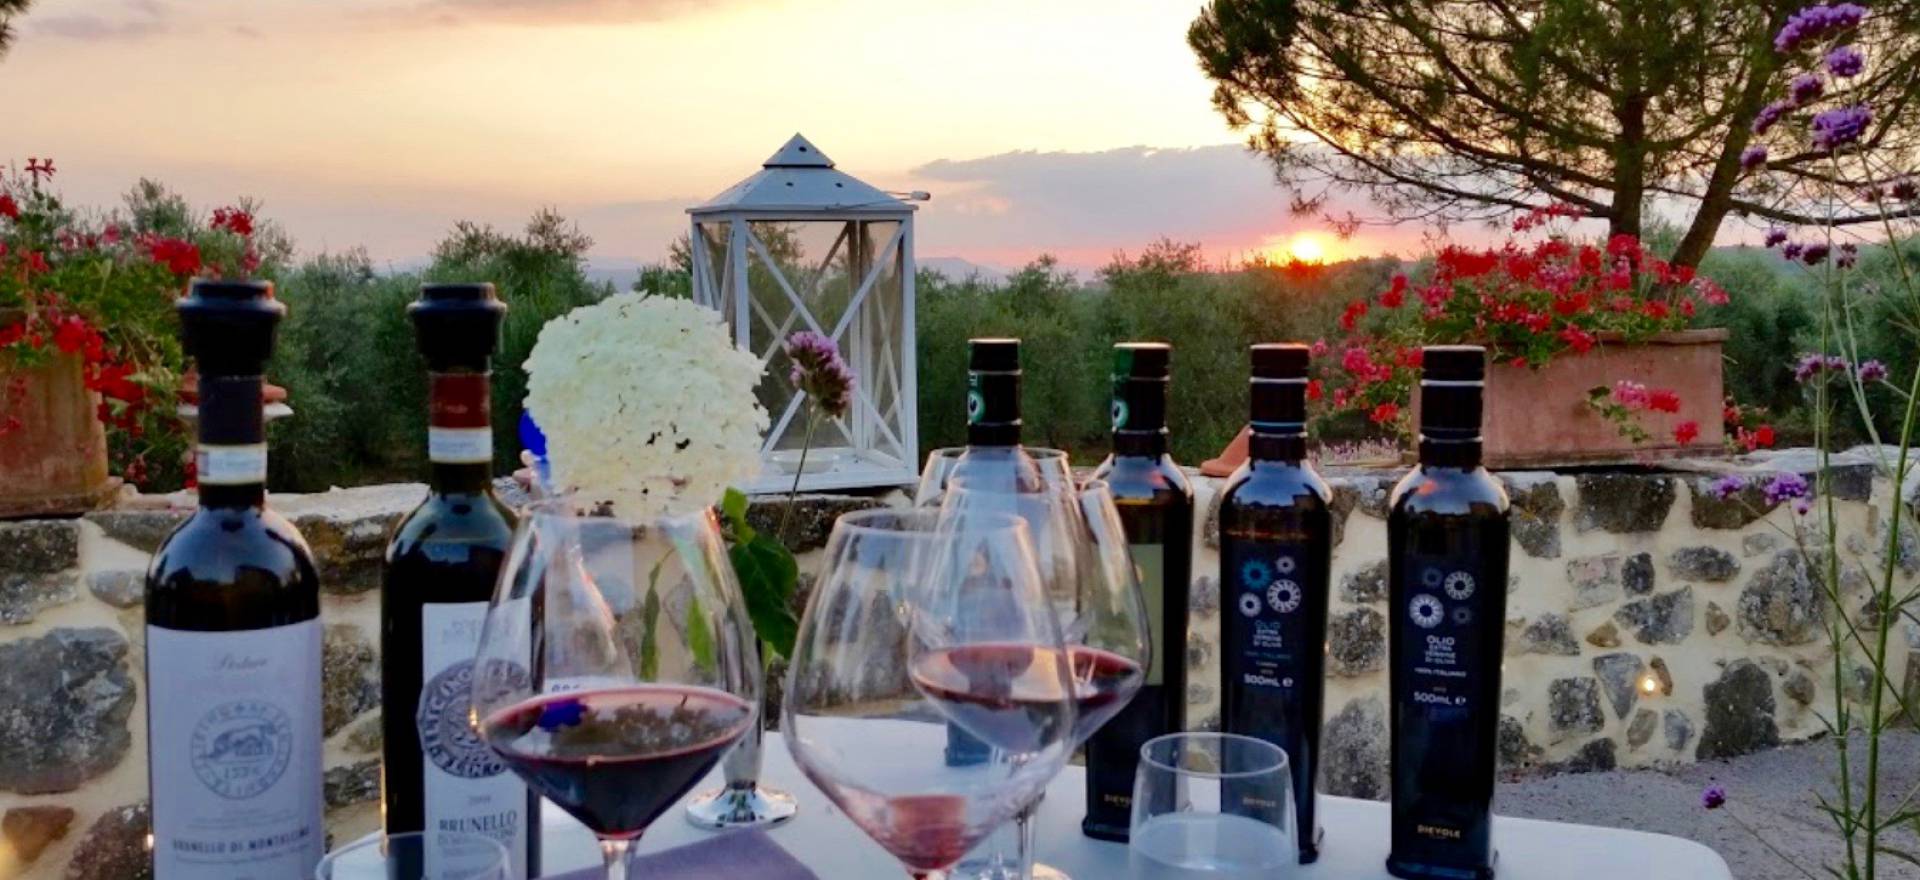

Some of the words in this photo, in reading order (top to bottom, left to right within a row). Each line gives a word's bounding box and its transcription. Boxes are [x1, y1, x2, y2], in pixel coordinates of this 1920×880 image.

[1426, 634, 1455, 646] OLIO
[439, 808, 518, 833] BRUNELLO
[1417, 823, 1461, 839] DIEVOLE
